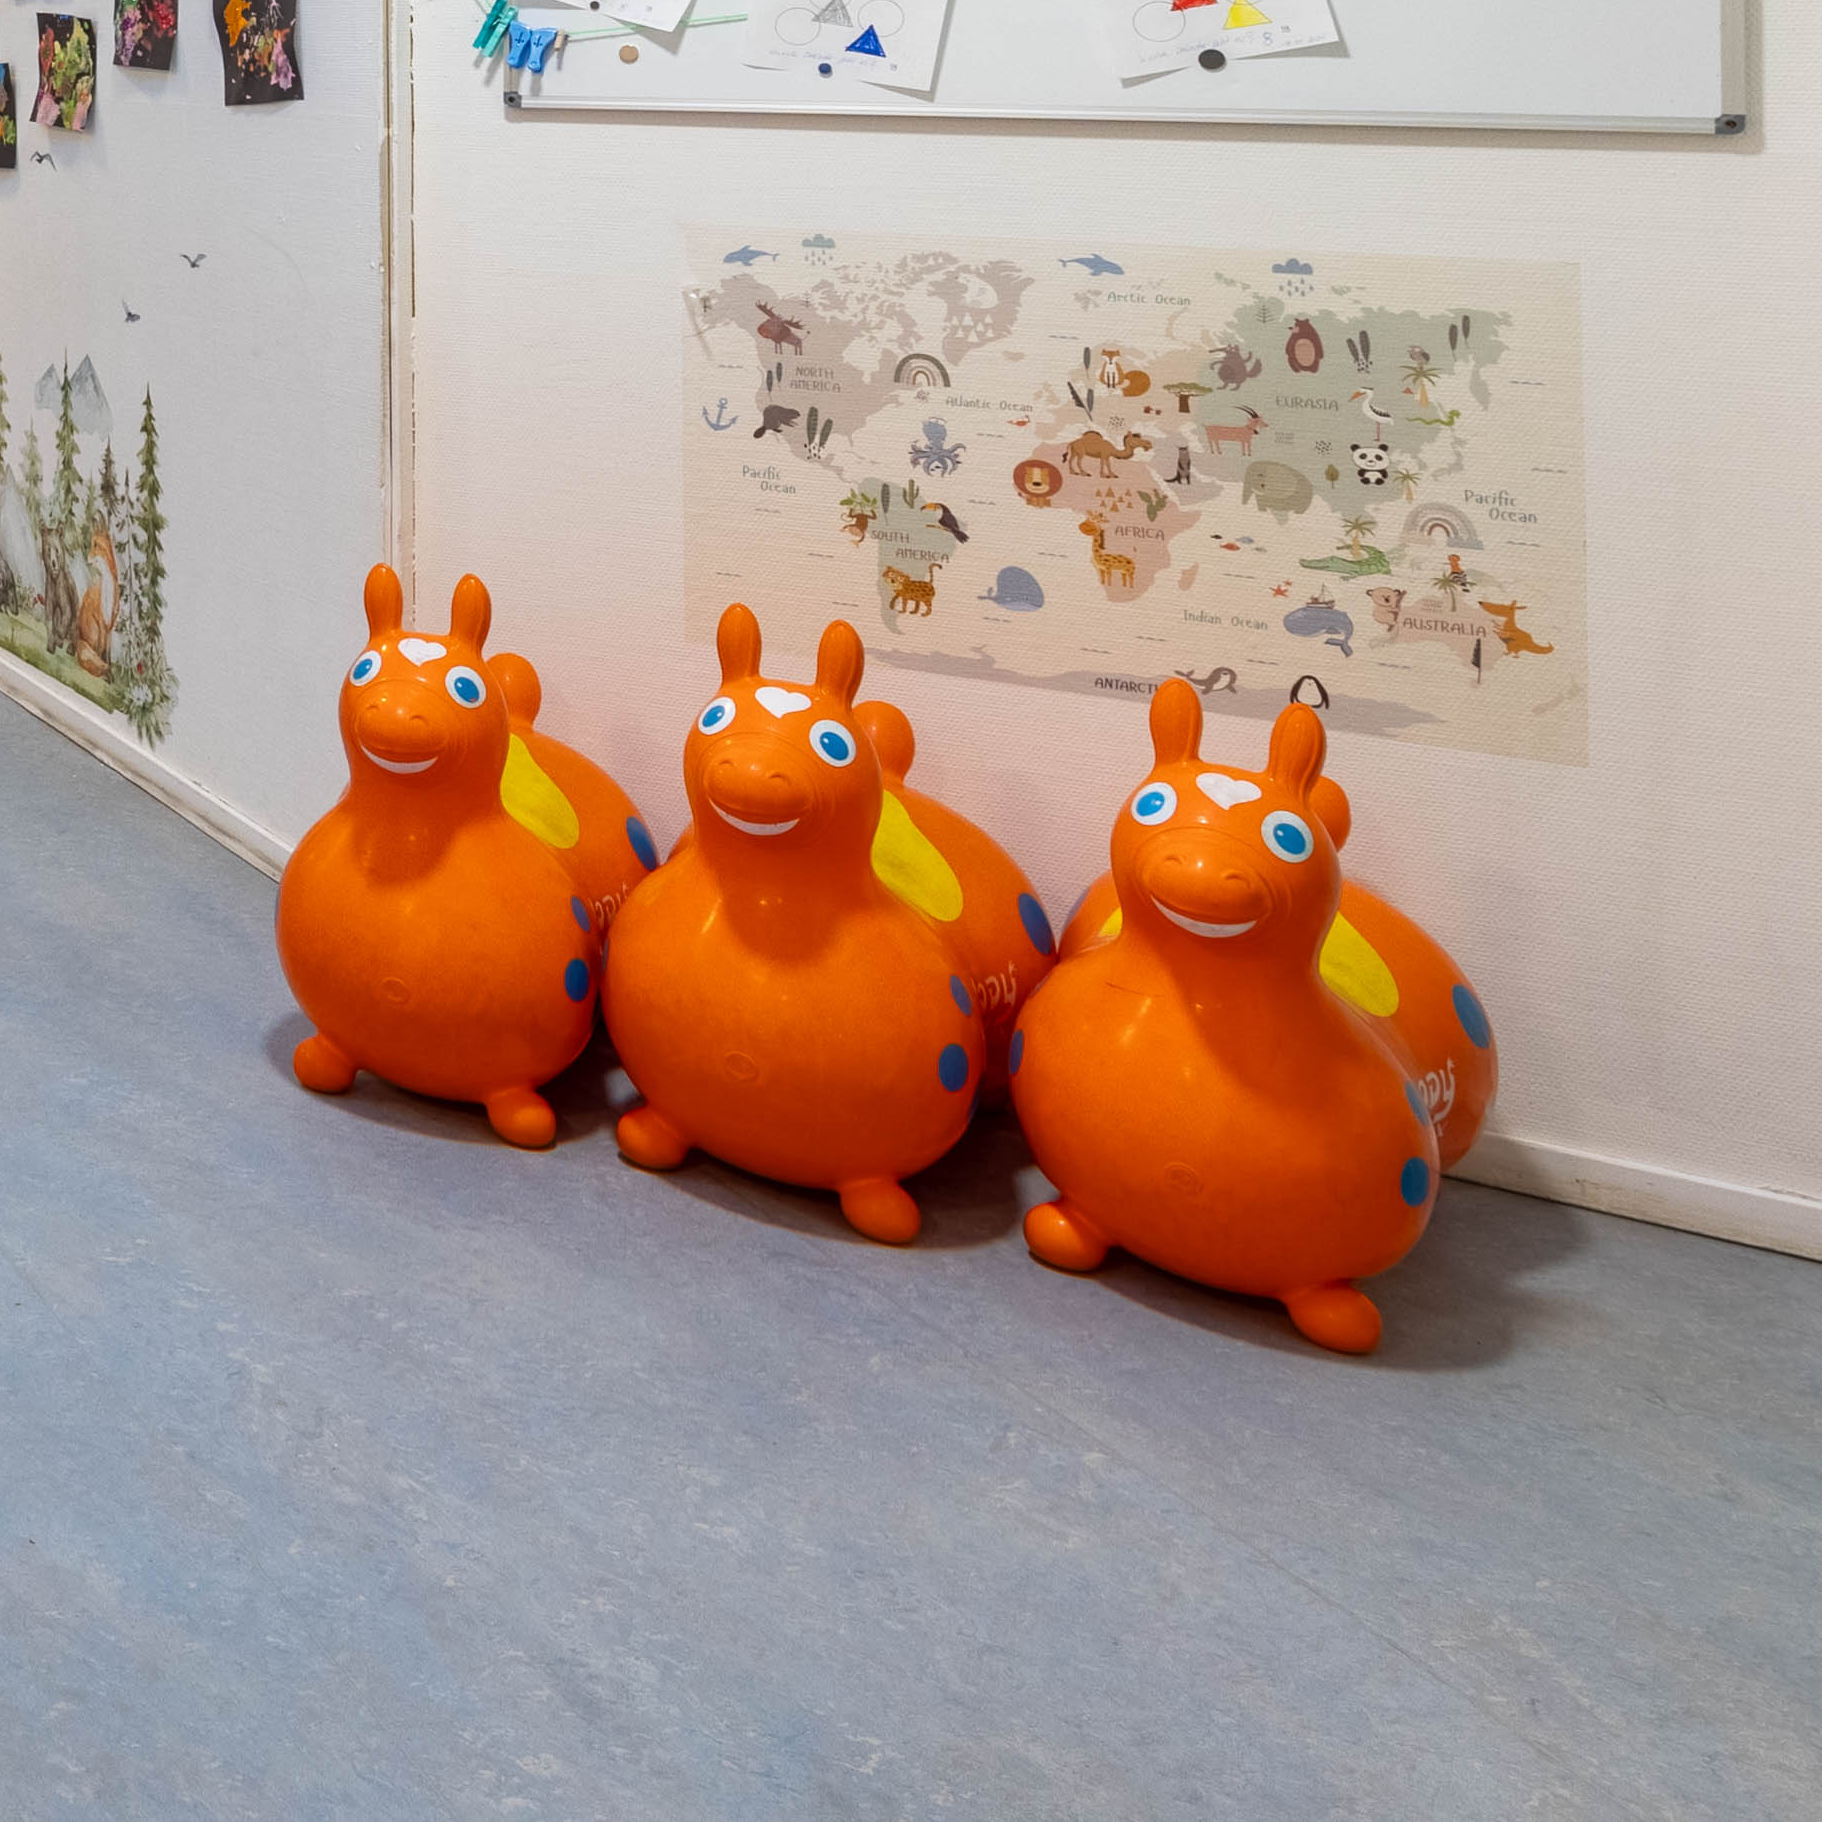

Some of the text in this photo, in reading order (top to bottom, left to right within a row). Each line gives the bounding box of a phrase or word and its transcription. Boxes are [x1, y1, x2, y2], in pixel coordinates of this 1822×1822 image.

[1106, 289, 1192, 307] Arctic Ocean
[794, 364, 835, 380] NORTH
[789, 378, 842, 393] AMERICA
[945, 394, 1034, 413] Atlantic Ocean
[1275, 394, 1340, 412] EURASIA
[742, 464, 782, 482] Pacific
[760, 480, 797, 495] Ocean
[1464, 488, 1518, 508] Pacific
[1489, 505, 1539, 525] Ocean
[870, 529, 911, 544] SOUTH
[1114, 524, 1166, 541] AFRICA
[894, 546, 951, 563] AMERICA
[1183, 609, 1269, 630] Indian Ocean
[1402, 616, 1488, 637] AUSTRALIA
